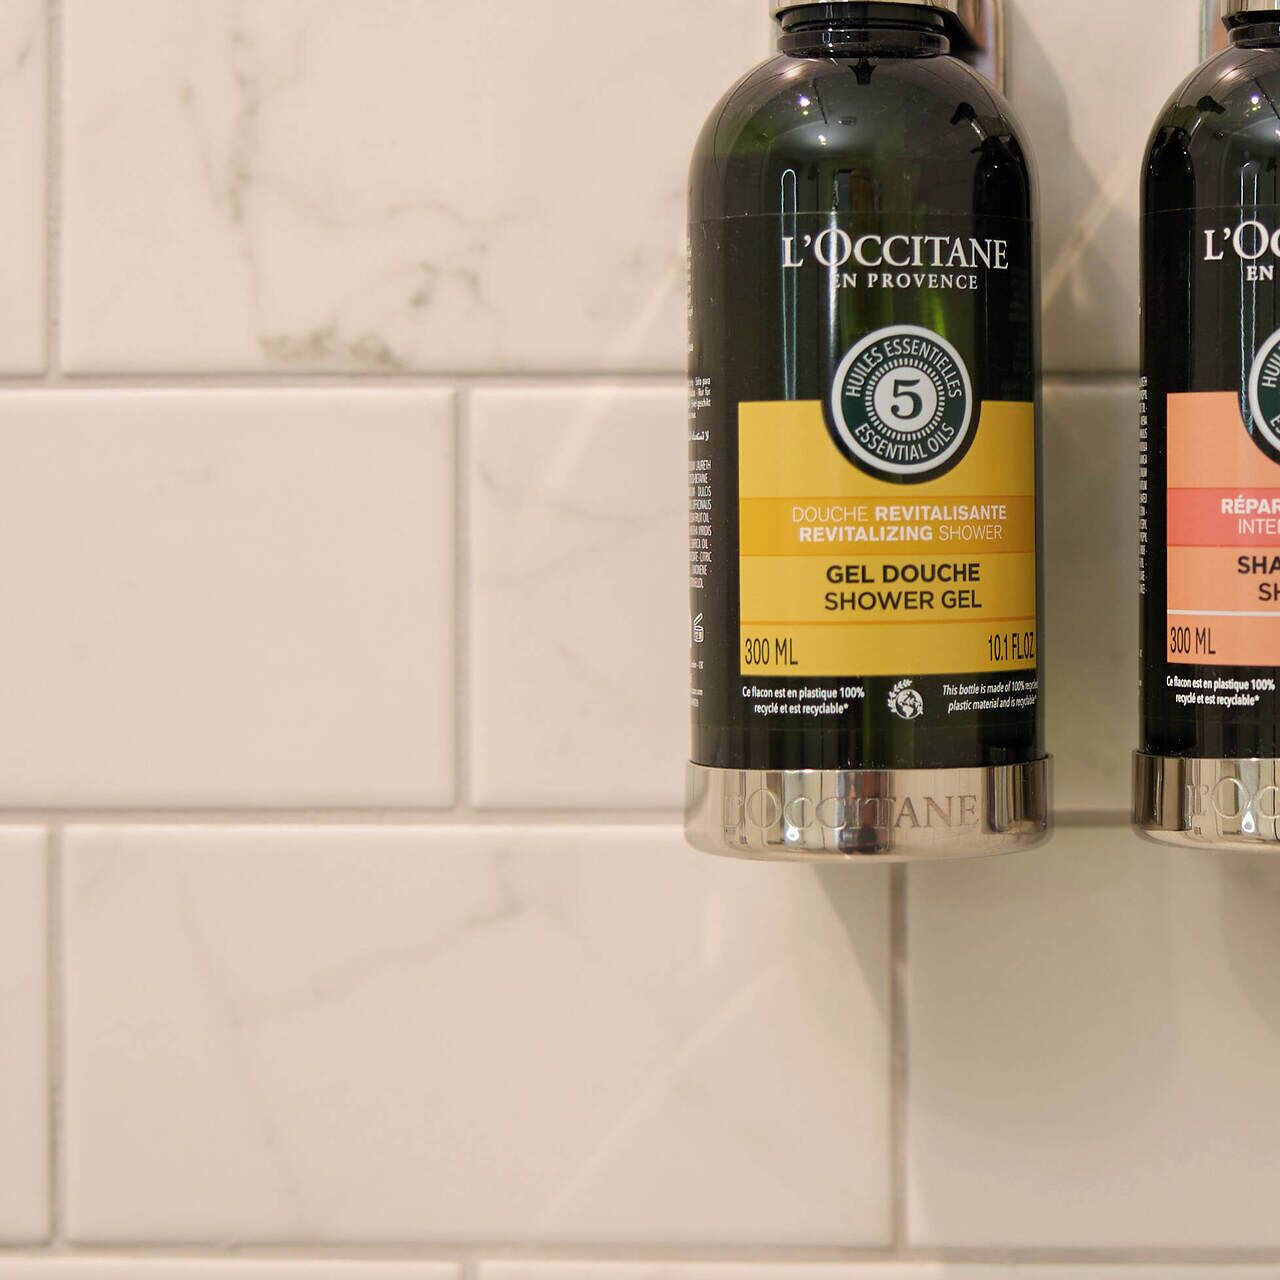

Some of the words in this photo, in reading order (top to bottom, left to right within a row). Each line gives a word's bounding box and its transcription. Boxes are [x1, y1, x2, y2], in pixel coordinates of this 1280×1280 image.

[781, 228, 1008, 270] L'OCCITANE
[834, 273, 857, 289] EN
[868, 273, 978, 290] PROVENCE
[1246, 265, 1274, 281] EN
[845, 348, 884, 398] HUILES
[884, 338, 962, 399] ESSENTIELLES
[890, 378, 922, 420] 5
[854, 422, 927, 461] ESSENTIAL
[927, 422, 956, 453] OILS
[792, 506, 868, 523] DOUCHE
[875, 504, 1007, 522] REVITALISANTE
[799, 526, 933, 543] REVITALIZING
[938, 525, 1003, 541] SHOWER
[826, 565, 875, 584] GEL
[882, 563, 980, 584] DOUCHE
[825, 591, 934, 611] SHOWER
[941, 590, 982, 609] GEL
[988, 633, 1008, 662] 10.1
[1170, 627, 1191, 655] 300
[1195, 627, 1216, 655] ML
[744, 638, 770, 665] 300
[775, 638, 798, 665] ML
[742, 686, 751, 698] Ce
[752, 685, 773, 698] flacon
[774, 688, 786, 698] est
[787, 689, 797, 698] en
[799, 686, 838, 701] plastique
[840, 686, 865, 698] 100%
[943, 684, 958, 696] This
[959, 683, 980, 695] bottle
[980, 683, 986, 694] is
[987, 682, 1005, 693] made
[1005, 681, 1011, 692] of
[1012, 680, 1025, 691] 100%
[1166, 675, 1173, 687] Ce
[1174, 675, 1191, 688] flacon
[1192, 678, 1202, 688] est
[1203, 680, 1213, 689] en
[1213, 677, 1249, 693] plastique
[1251, 678, 1276, 691] 100%
[947, 699, 972, 714] plastic
[972, 697, 999, 710] material
[999, 696, 1011, 708] and
[1011, 696, 1016, 707] is
[1175, 692, 1196, 706] recyclé
[1196, 695, 1204, 704] et
[1205, 694, 1216, 705] est
[754, 702, 779, 716] recyclé
[780, 704, 788, 713] et
[789, 704, 801, 714] est
